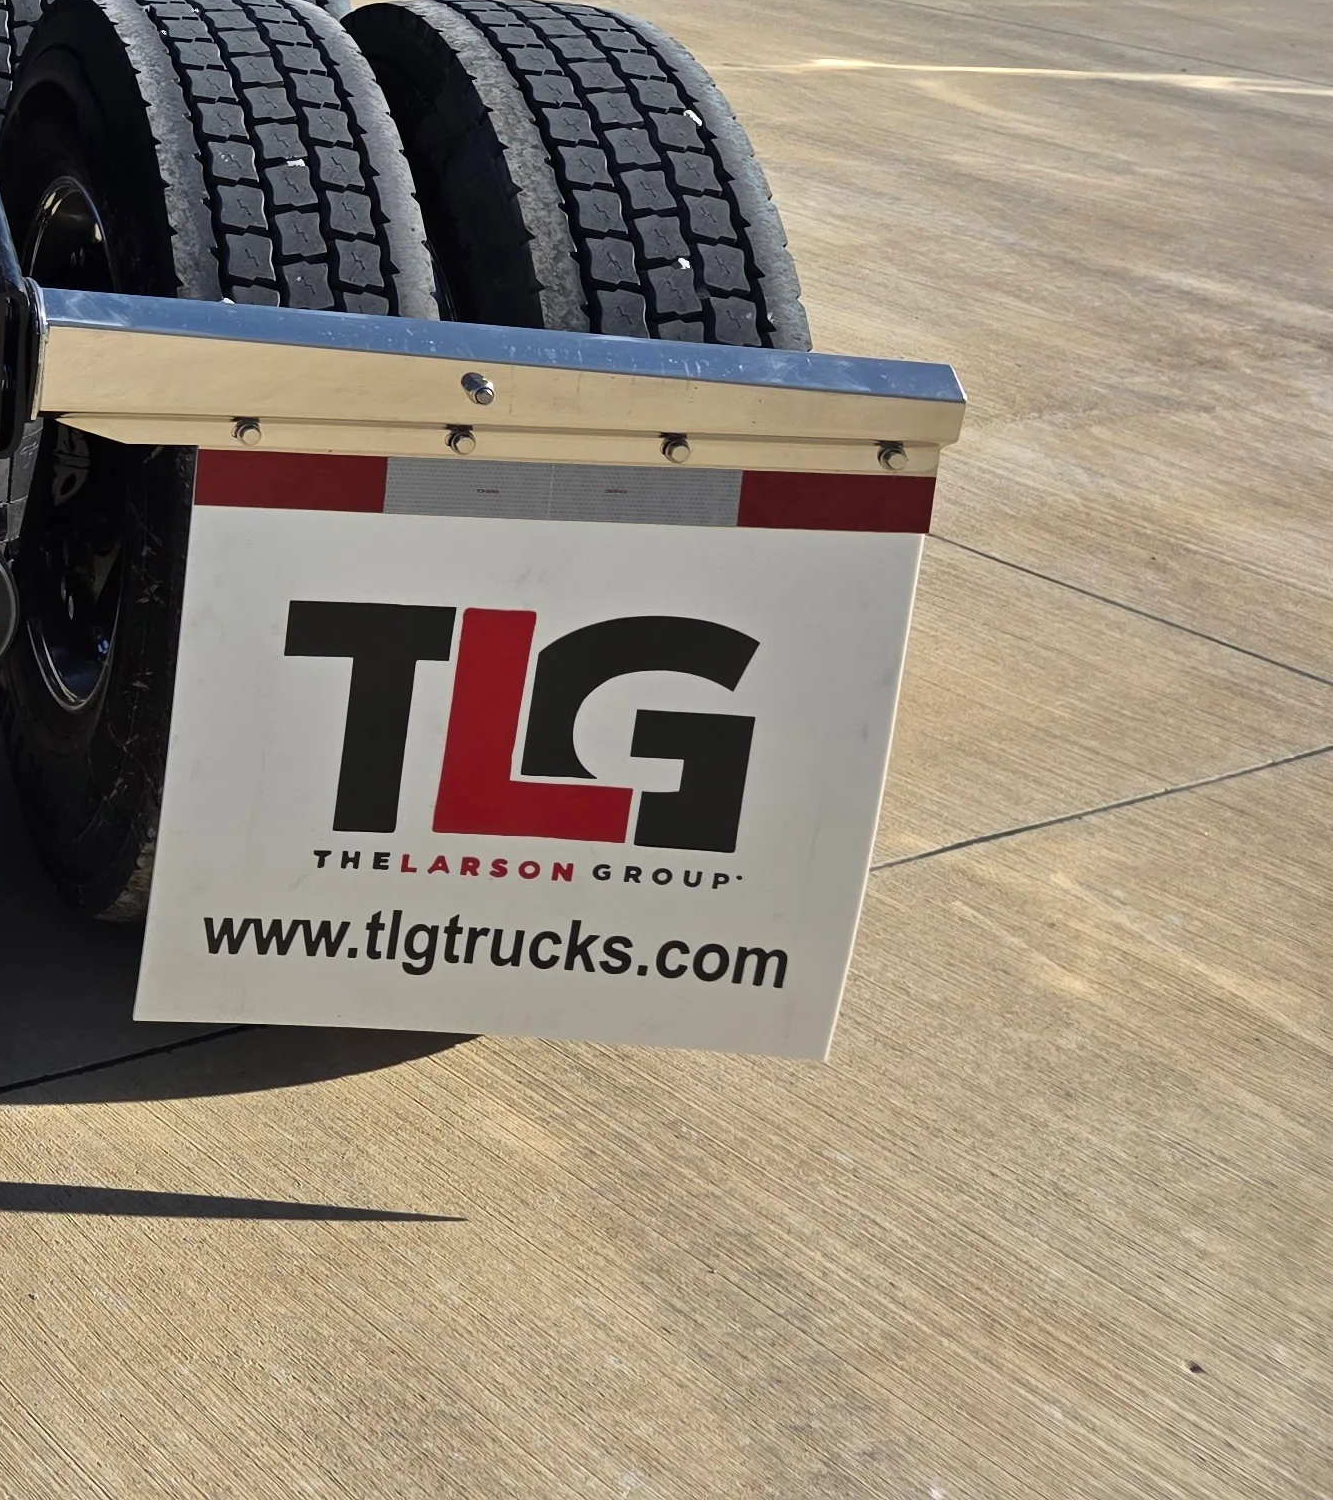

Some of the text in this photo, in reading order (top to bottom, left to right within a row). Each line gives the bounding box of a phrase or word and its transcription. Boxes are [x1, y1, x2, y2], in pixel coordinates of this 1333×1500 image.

[283, 599, 761, 854] TLG
[592, 863, 731, 890] GROUP
[203, 909, 788, 989] www.tlgtrucks.com
